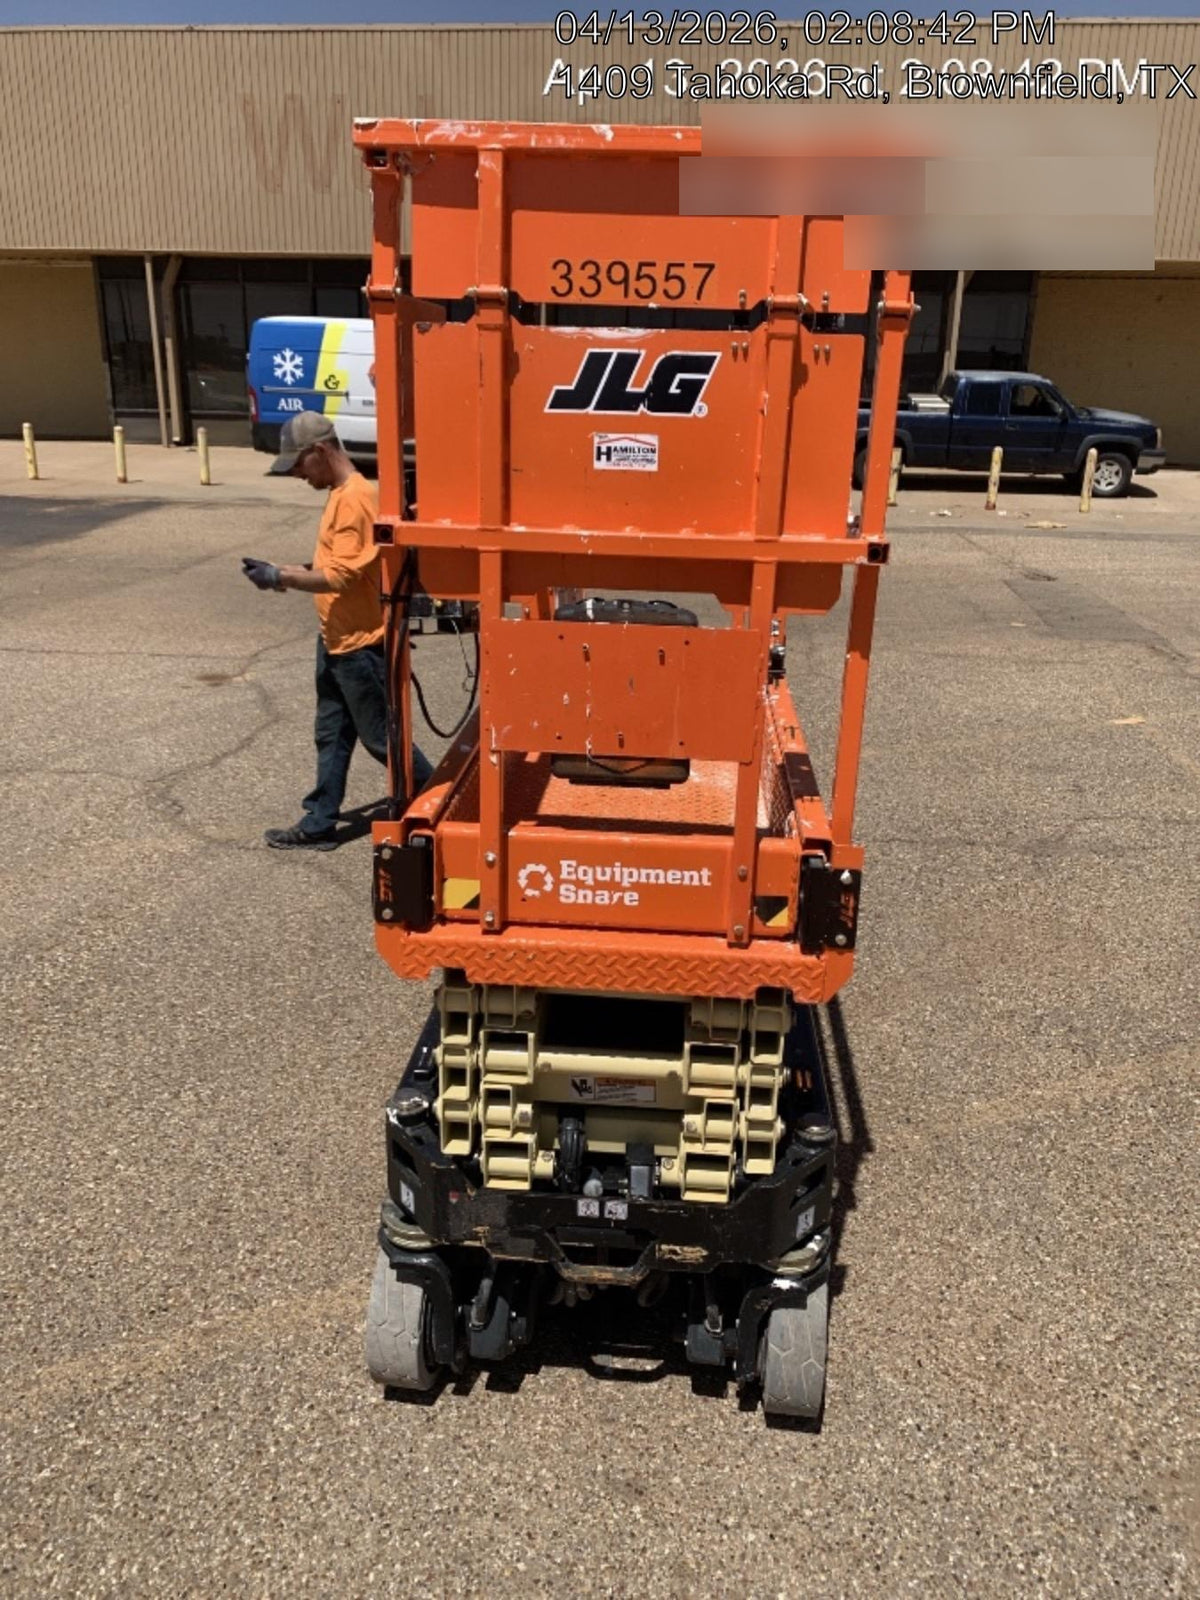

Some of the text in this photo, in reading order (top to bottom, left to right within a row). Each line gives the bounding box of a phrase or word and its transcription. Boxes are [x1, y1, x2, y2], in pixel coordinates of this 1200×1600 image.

[550, 259, 716, 301] 339557
[323, 374, 340, 390] &
[544, 347, 722, 417] JLG
[277, 397, 304, 412] AIR
[596, 446, 657, 462] HAMILTON
[559, 859, 712, 887] Equipment
